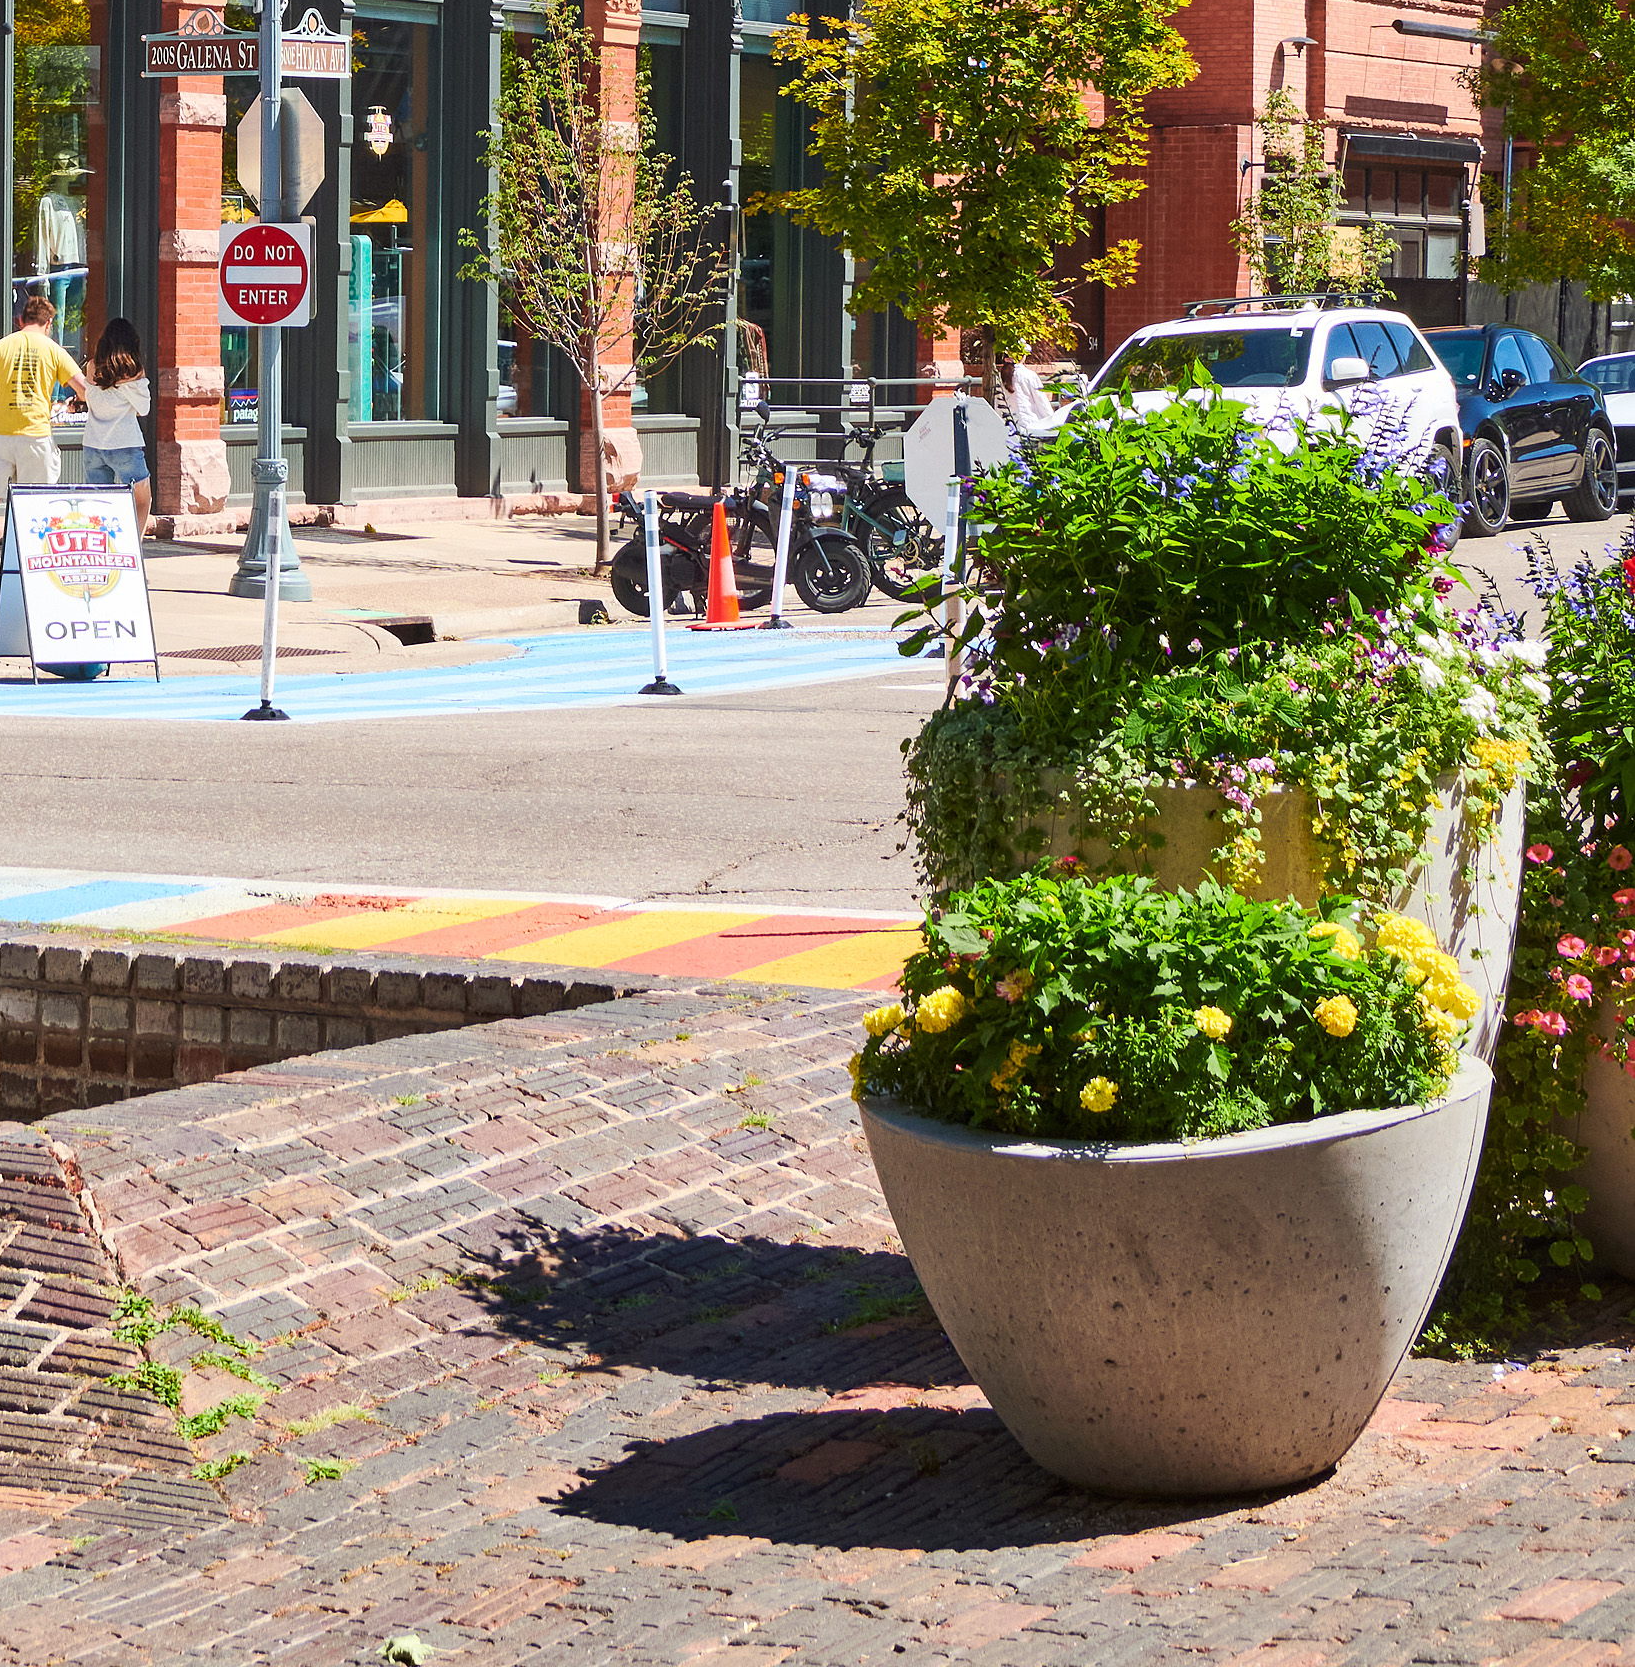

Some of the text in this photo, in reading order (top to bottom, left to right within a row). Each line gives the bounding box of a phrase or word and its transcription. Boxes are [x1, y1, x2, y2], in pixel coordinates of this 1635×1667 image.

[150, 40, 256, 70] 200S GALENA ST
[329, 44, 345, 72] AVE
[234, 245, 295, 261] DO NOT
[239, 289, 288, 305] ENTER
[1088, 336, 1098, 351] 514
[51, 531, 105, 553] UTE
[29, 555, 134, 569] MOUNTAINEER
[64, 574, 105, 584] ASPEN
[45, 620, 137, 640] OPEN
